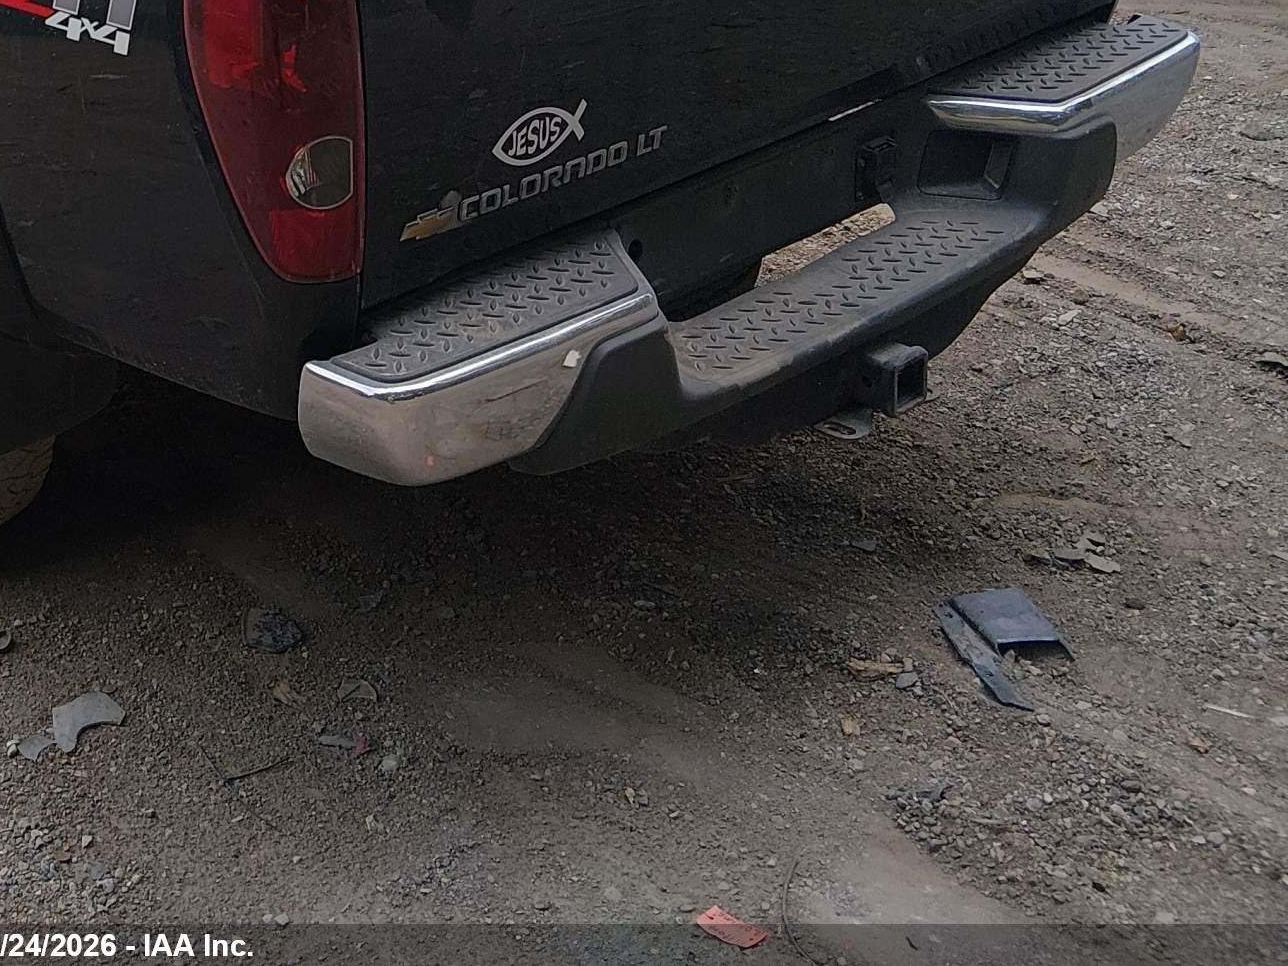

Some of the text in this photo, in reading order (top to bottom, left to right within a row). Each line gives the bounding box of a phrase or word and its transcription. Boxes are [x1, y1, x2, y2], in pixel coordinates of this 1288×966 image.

[508, 116, 562, 156] JESUS
[460, 125, 668, 221] COLORADO LT
